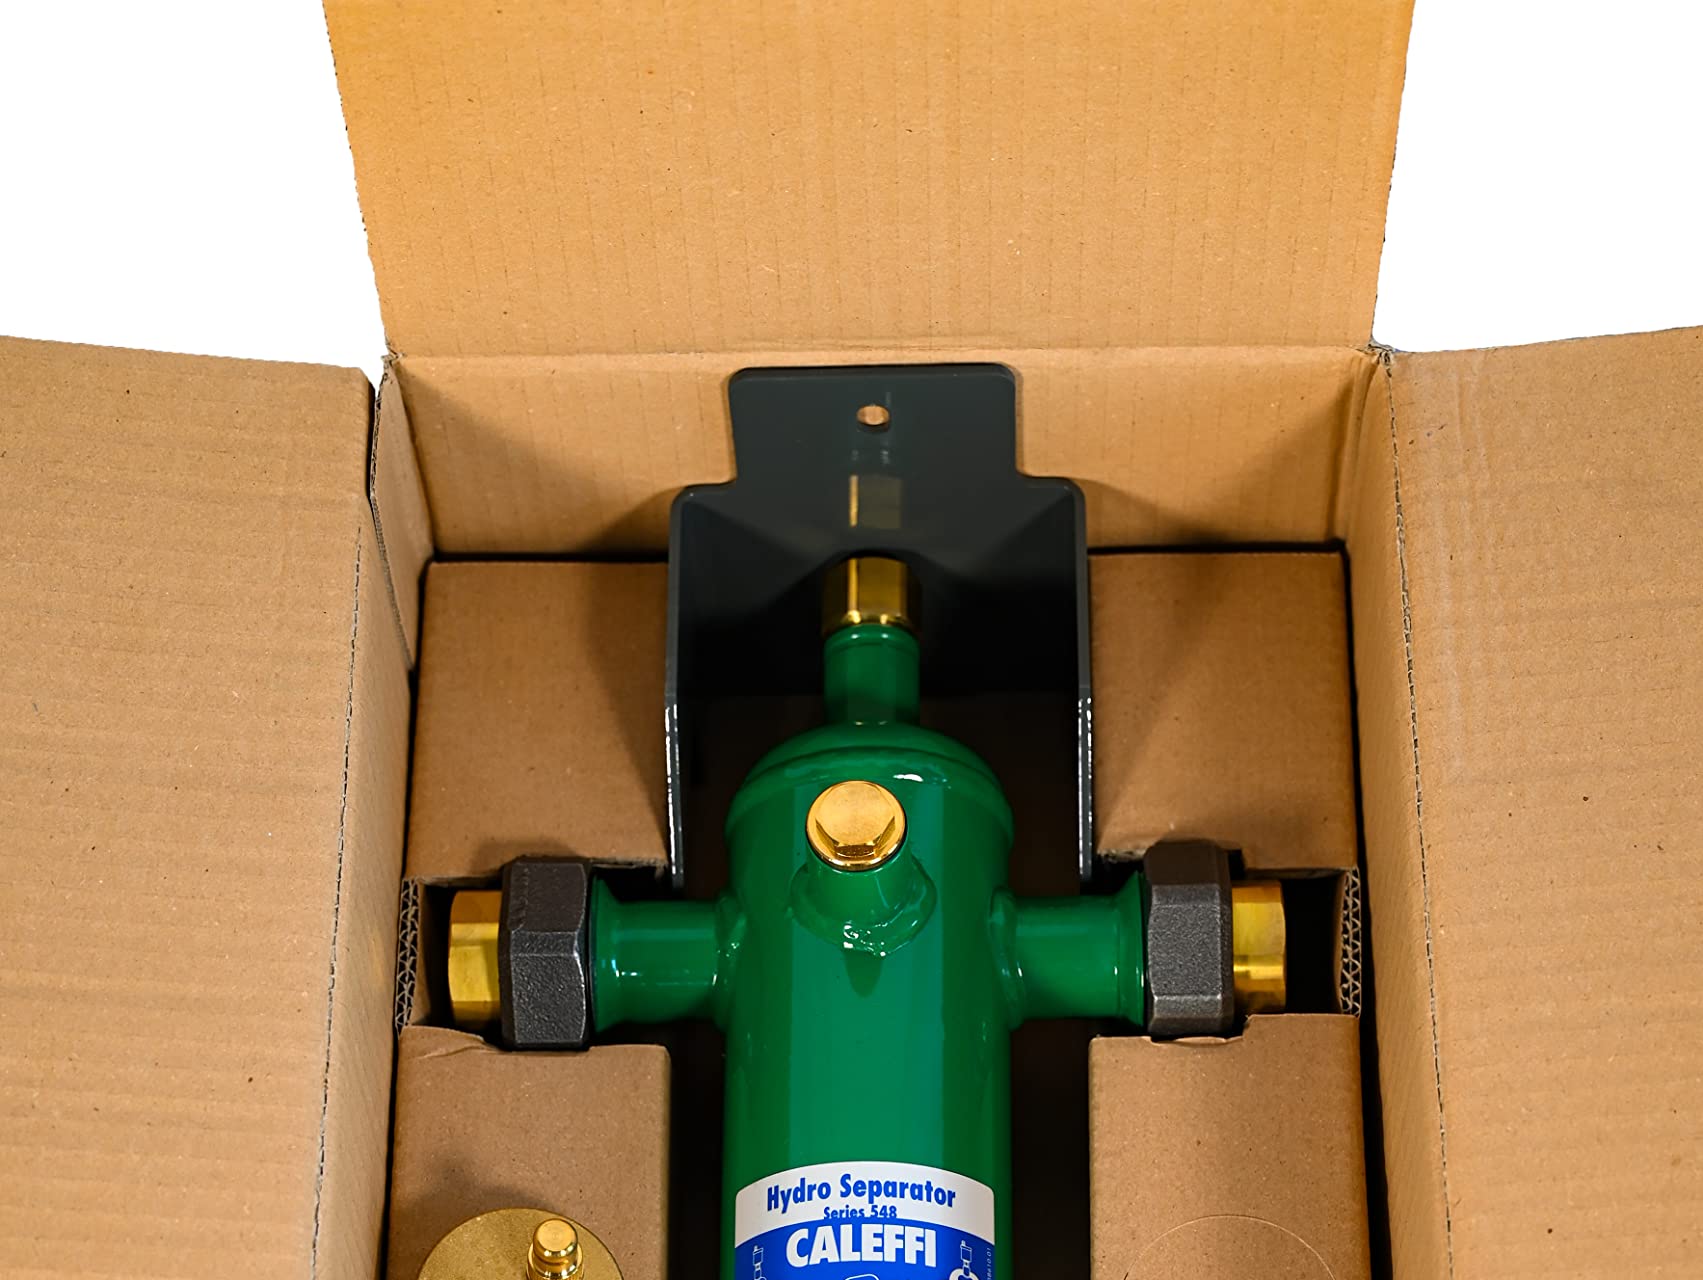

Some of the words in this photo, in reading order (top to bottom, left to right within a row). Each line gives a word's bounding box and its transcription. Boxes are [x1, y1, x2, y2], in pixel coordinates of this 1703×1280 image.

[767, 1177, 832, 1214] Hydro
[839, 1173, 956, 1208] Separator
[823, 1204, 865, 1219] Series
[870, 1205, 897, 1219] 548
[785, 1223, 937, 1268] CALEFFI
